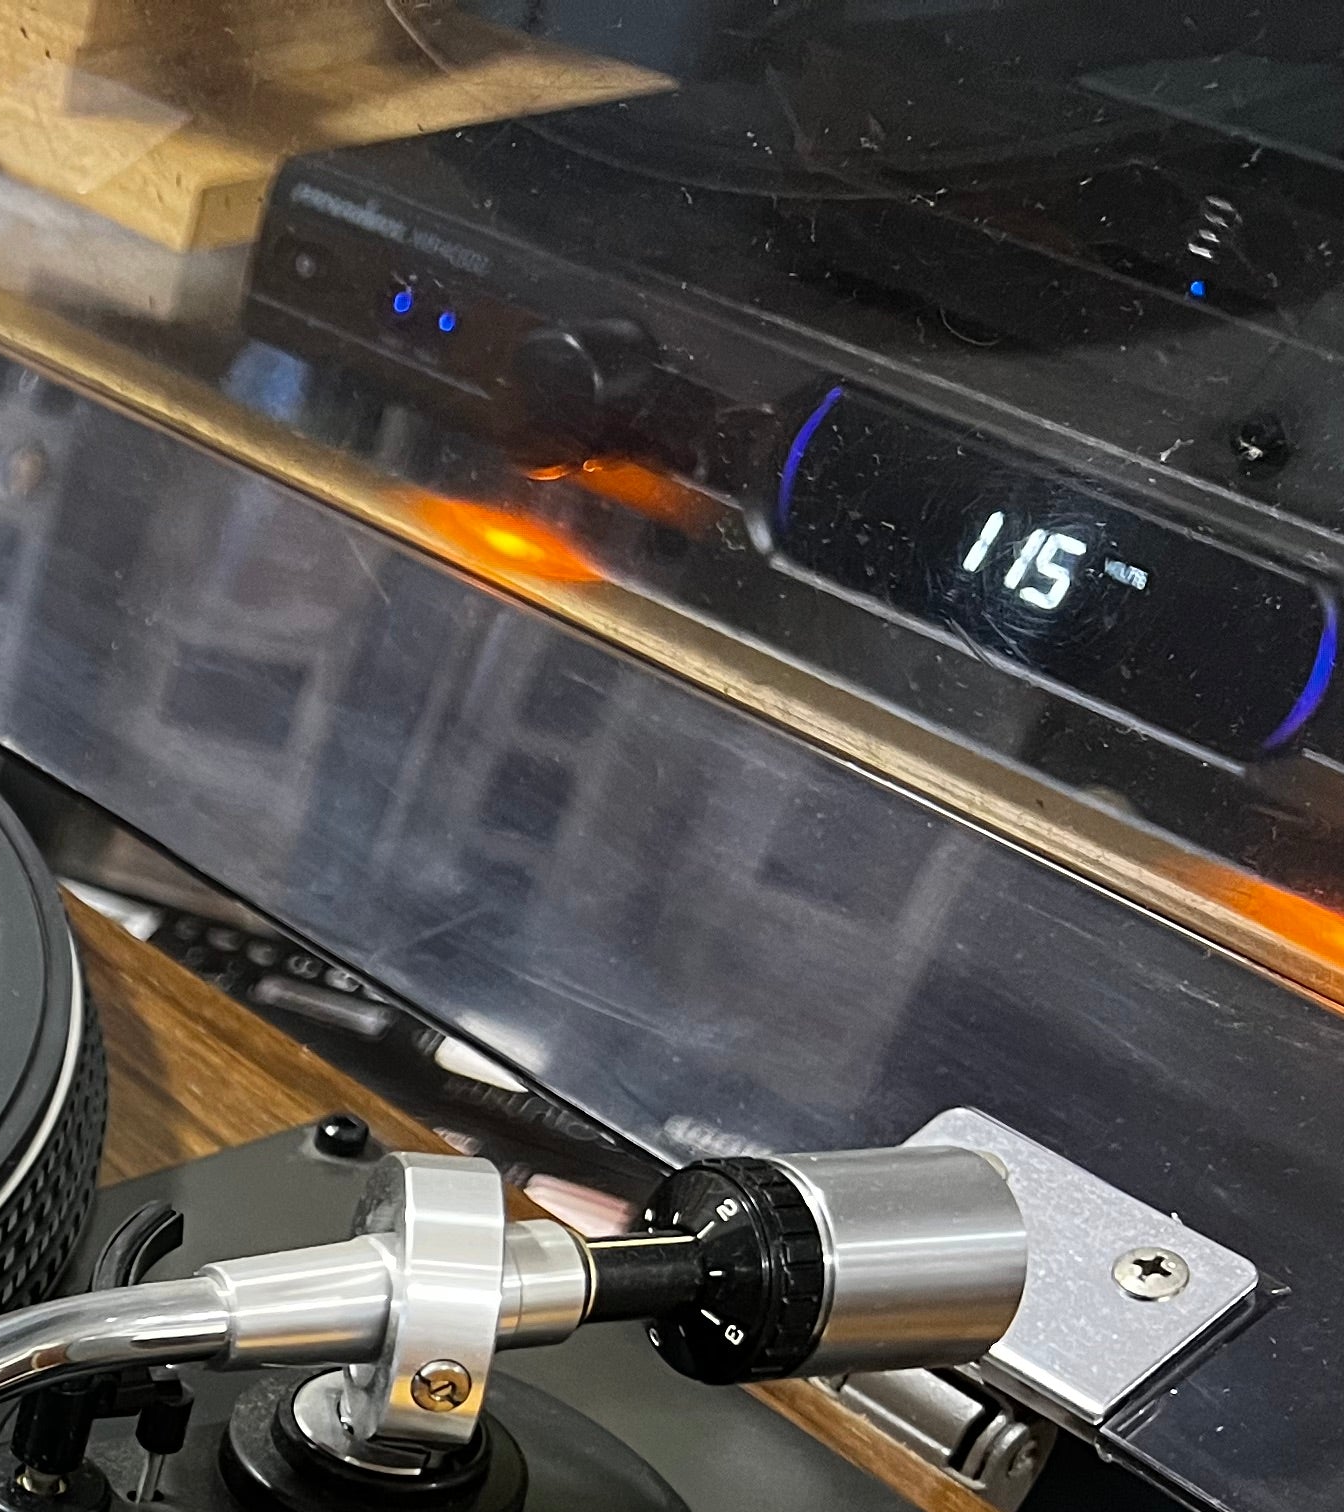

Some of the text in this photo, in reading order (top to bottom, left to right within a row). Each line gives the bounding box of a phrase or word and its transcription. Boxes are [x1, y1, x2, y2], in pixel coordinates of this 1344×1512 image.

[963, 511, 1087, 610] 115
[716, 1198, 738, 1222] 2
[724, 1324, 744, 1345] 3
